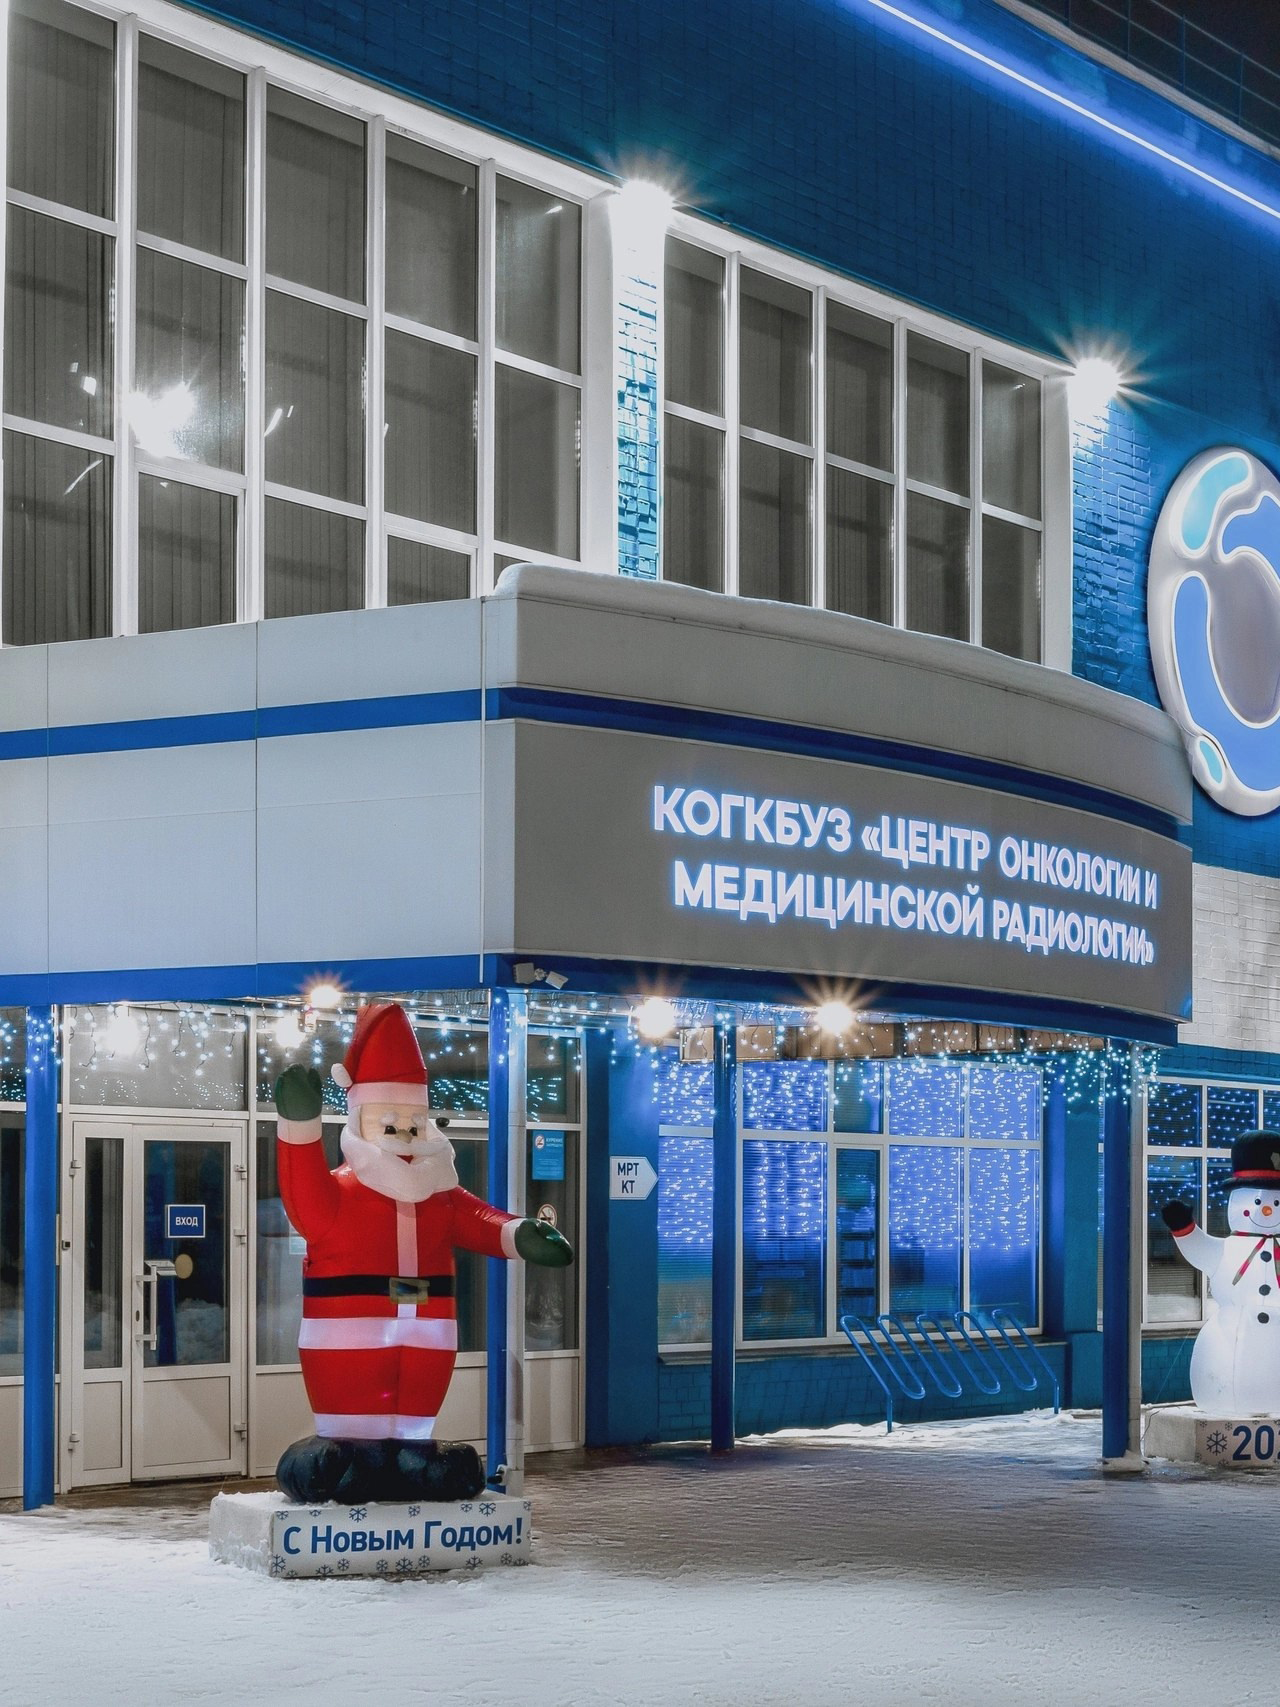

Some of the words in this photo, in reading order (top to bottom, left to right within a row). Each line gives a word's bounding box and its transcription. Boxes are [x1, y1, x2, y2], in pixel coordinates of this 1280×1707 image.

[654, 785, 851, 852] КОГКБУЗ
[861, 815, 990, 872] «ЦЕНТР
[1000, 836, 1141, 906] ОНКОЛОГИИ
[1144, 870, 1157, 909] И
[674, 860, 983, 938] МЕДИЦИНСКОЙ
[993, 899, 1154, 966] РАДИОЛОГИИ»
[617, 1162, 639, 1176] МРТ
[621, 1180, 635, 1193] КТ
[175, 1216, 198, 1227] ВХОД
[283, 1526, 301, 1555] С
[311, 1525, 414, 1554] Новым
[424, 1517, 522, 1551] Годом!
